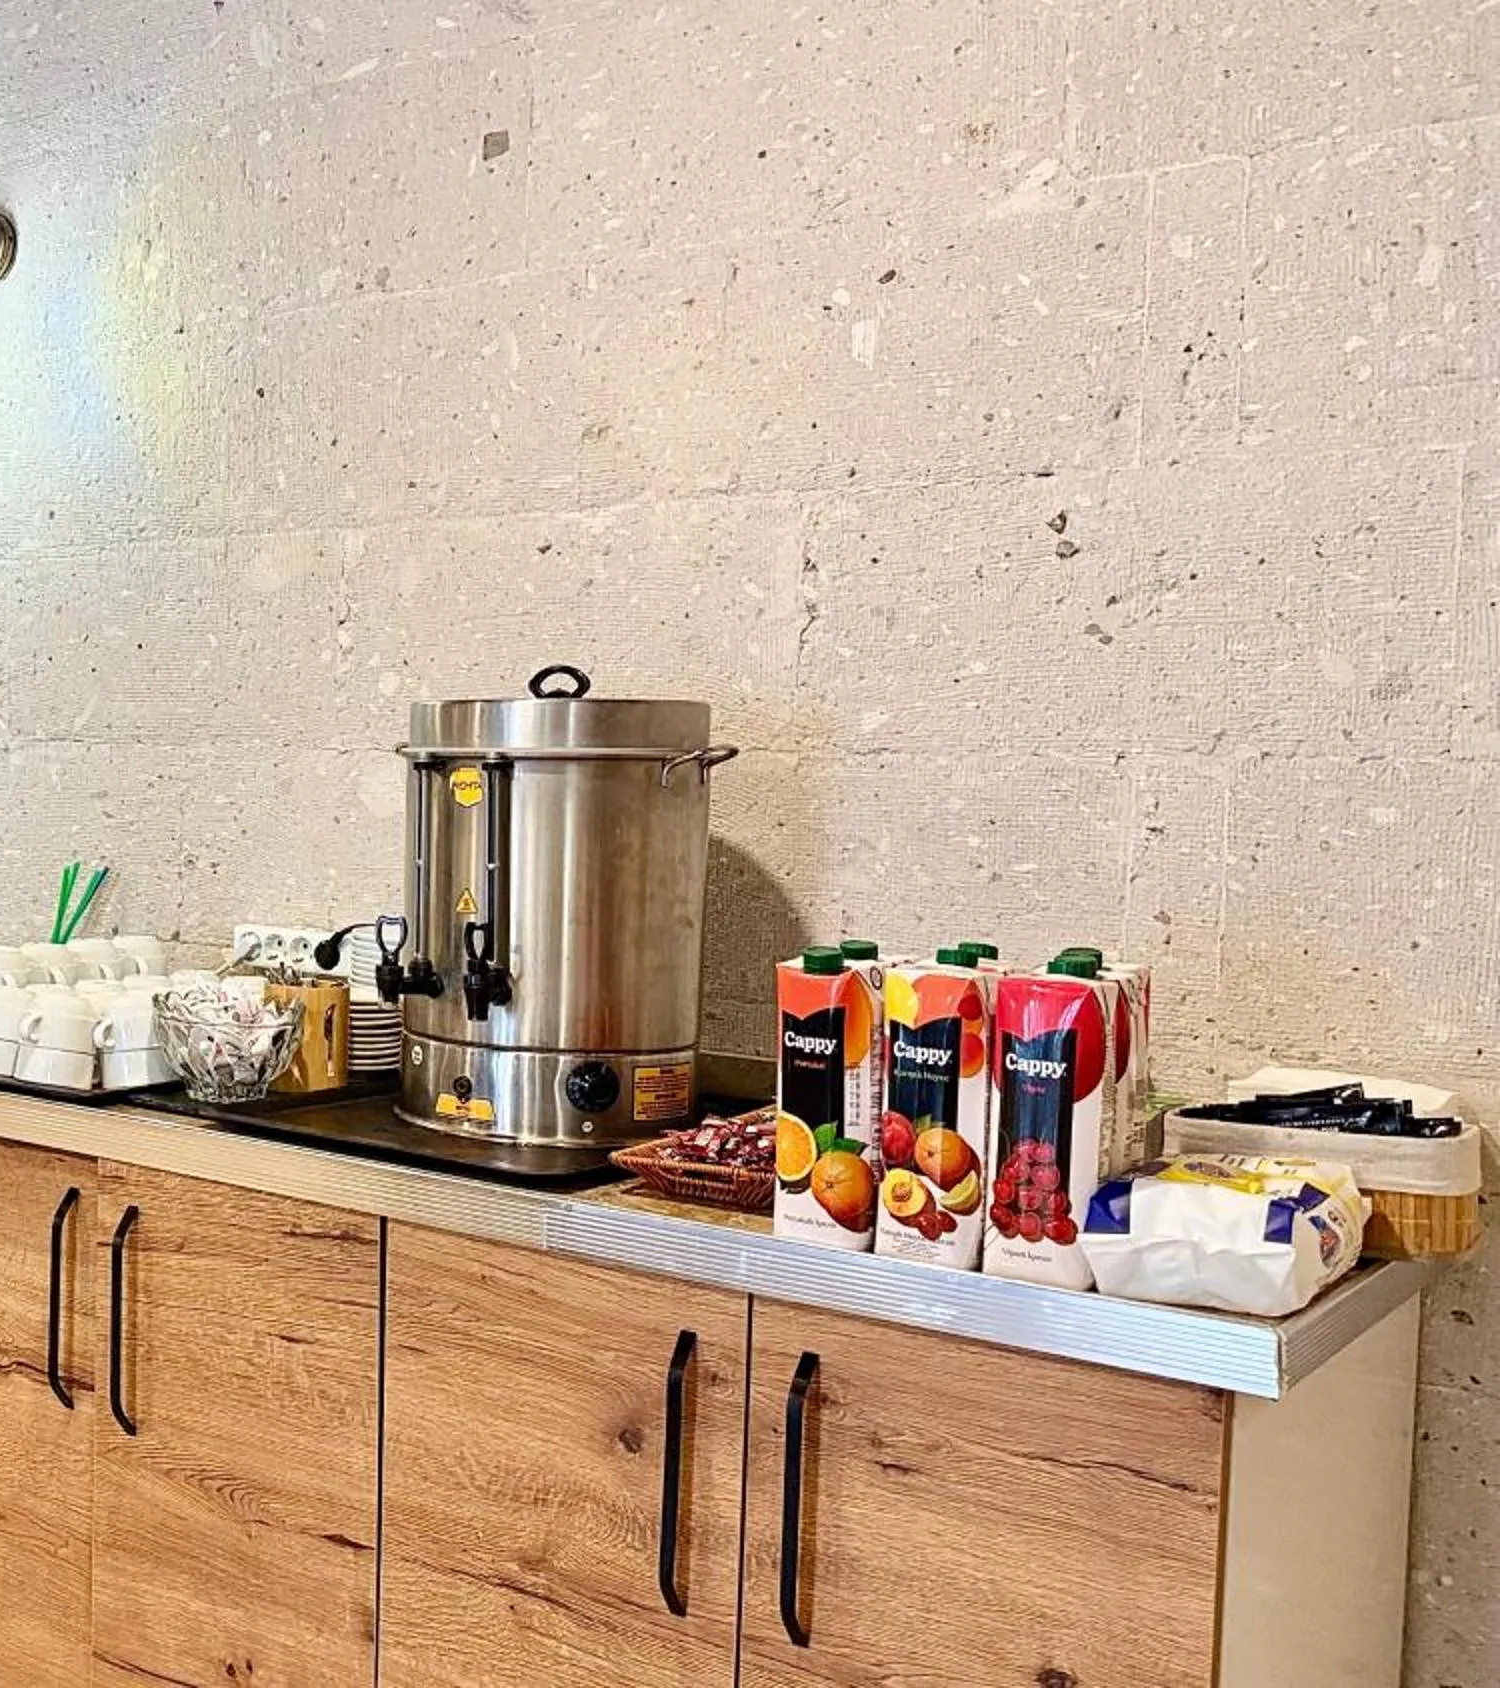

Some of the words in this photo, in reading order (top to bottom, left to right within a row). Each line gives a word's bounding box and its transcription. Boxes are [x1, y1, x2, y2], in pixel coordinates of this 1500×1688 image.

[784, 1031, 837, 1055] Cappy
[893, 1041, 952, 1066] Cappy
[1005, 1053, 1067, 1079] Cappy
